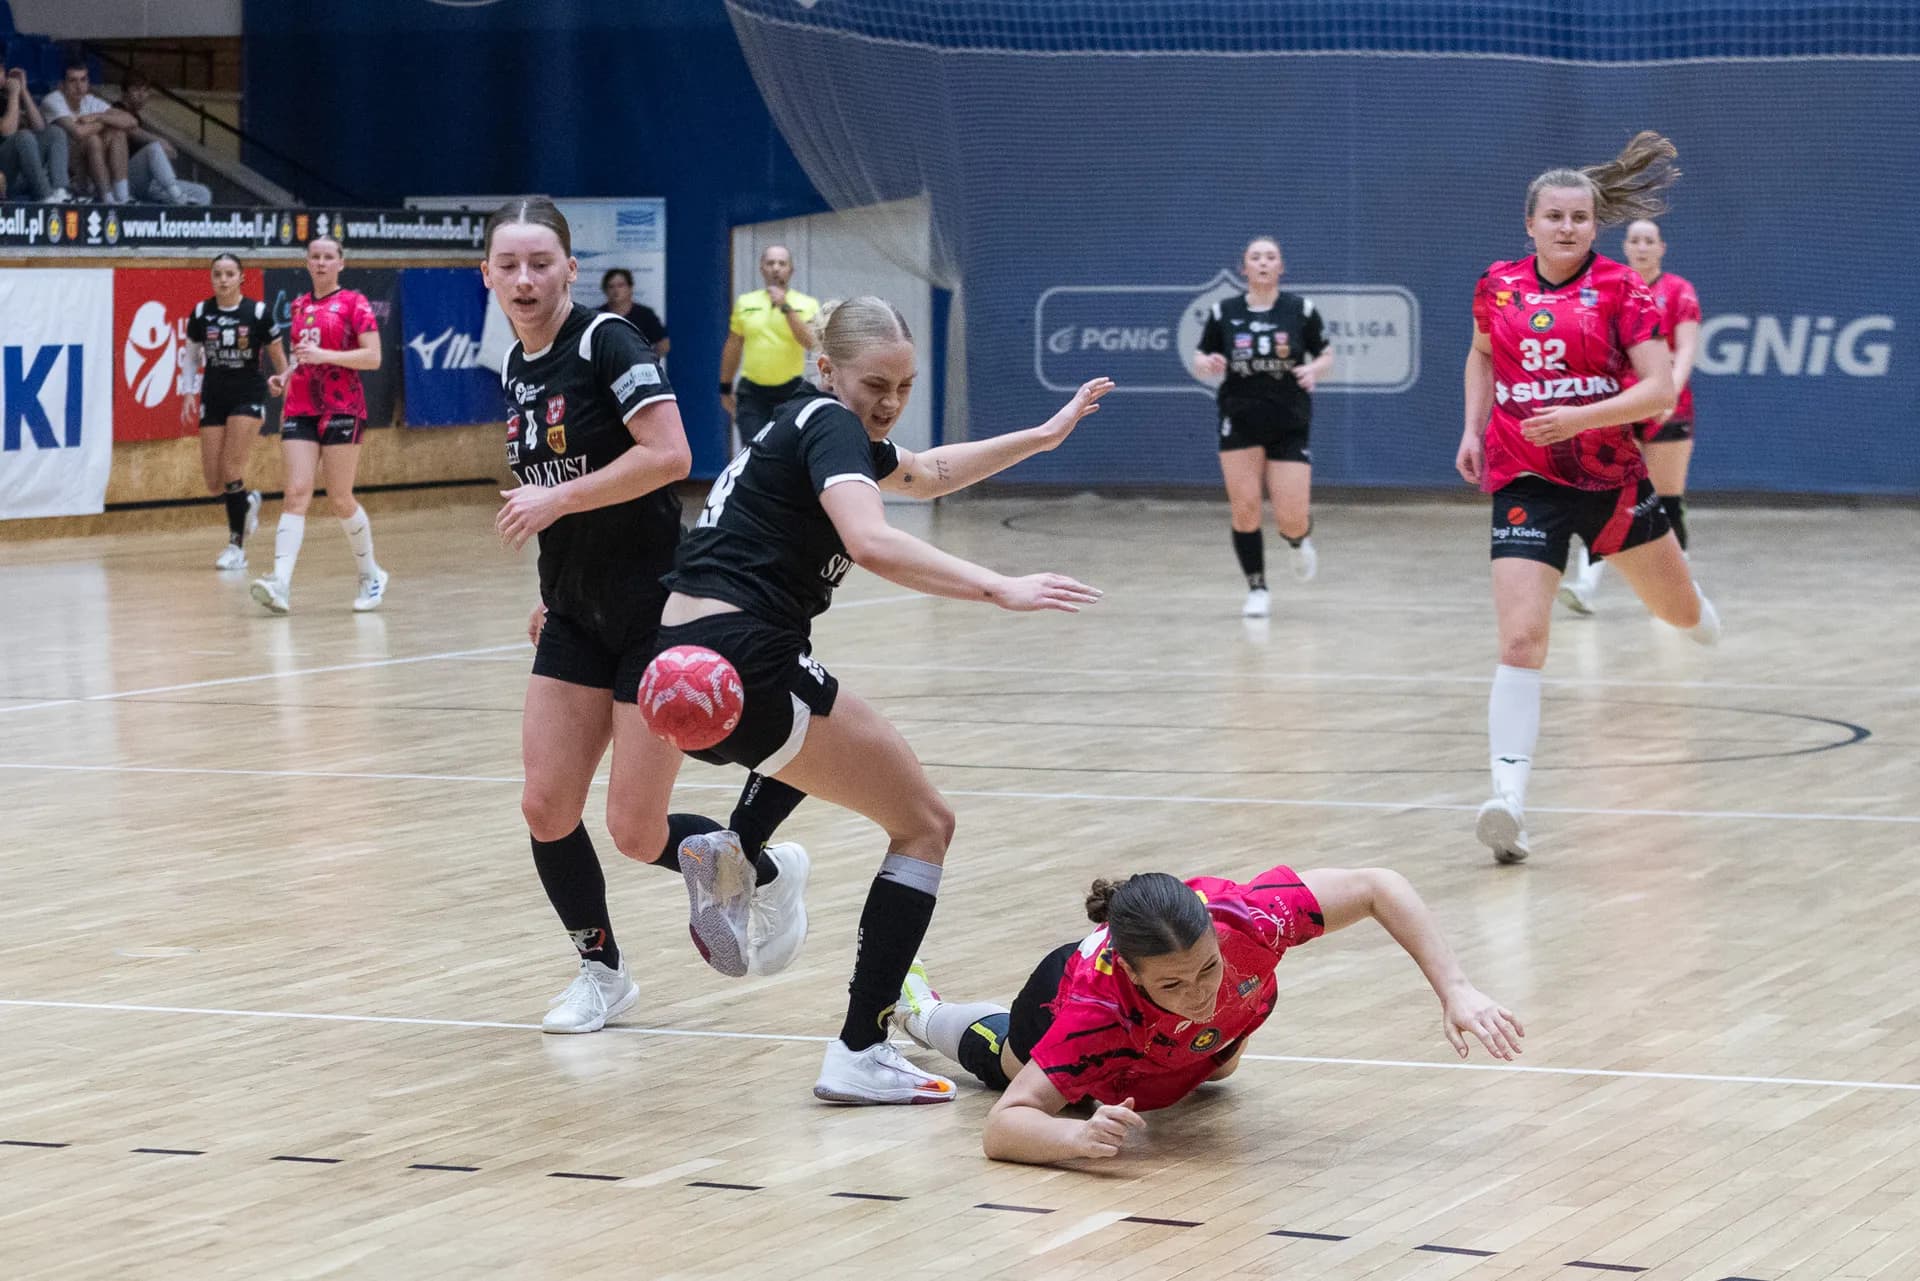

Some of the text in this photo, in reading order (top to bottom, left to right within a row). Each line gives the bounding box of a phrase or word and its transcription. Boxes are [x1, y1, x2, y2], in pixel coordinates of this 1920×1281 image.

[122, 211, 277, 246] www.koronahandball.pl
[347, 213, 485, 247] www.koronahandball.pl
[1080, 328, 1170, 350] PGNiG
[1328, 320, 1397, 337] RLIGA
[1694, 314, 1895, 376] GNiG
[1519, 338, 1566, 371] 32
[3, 344, 83, 452] KI
[1511, 375, 1620, 403] SUZUKI
[525, 454, 587, 489] OLKUSZ
[820, 553, 849, 582] SP
